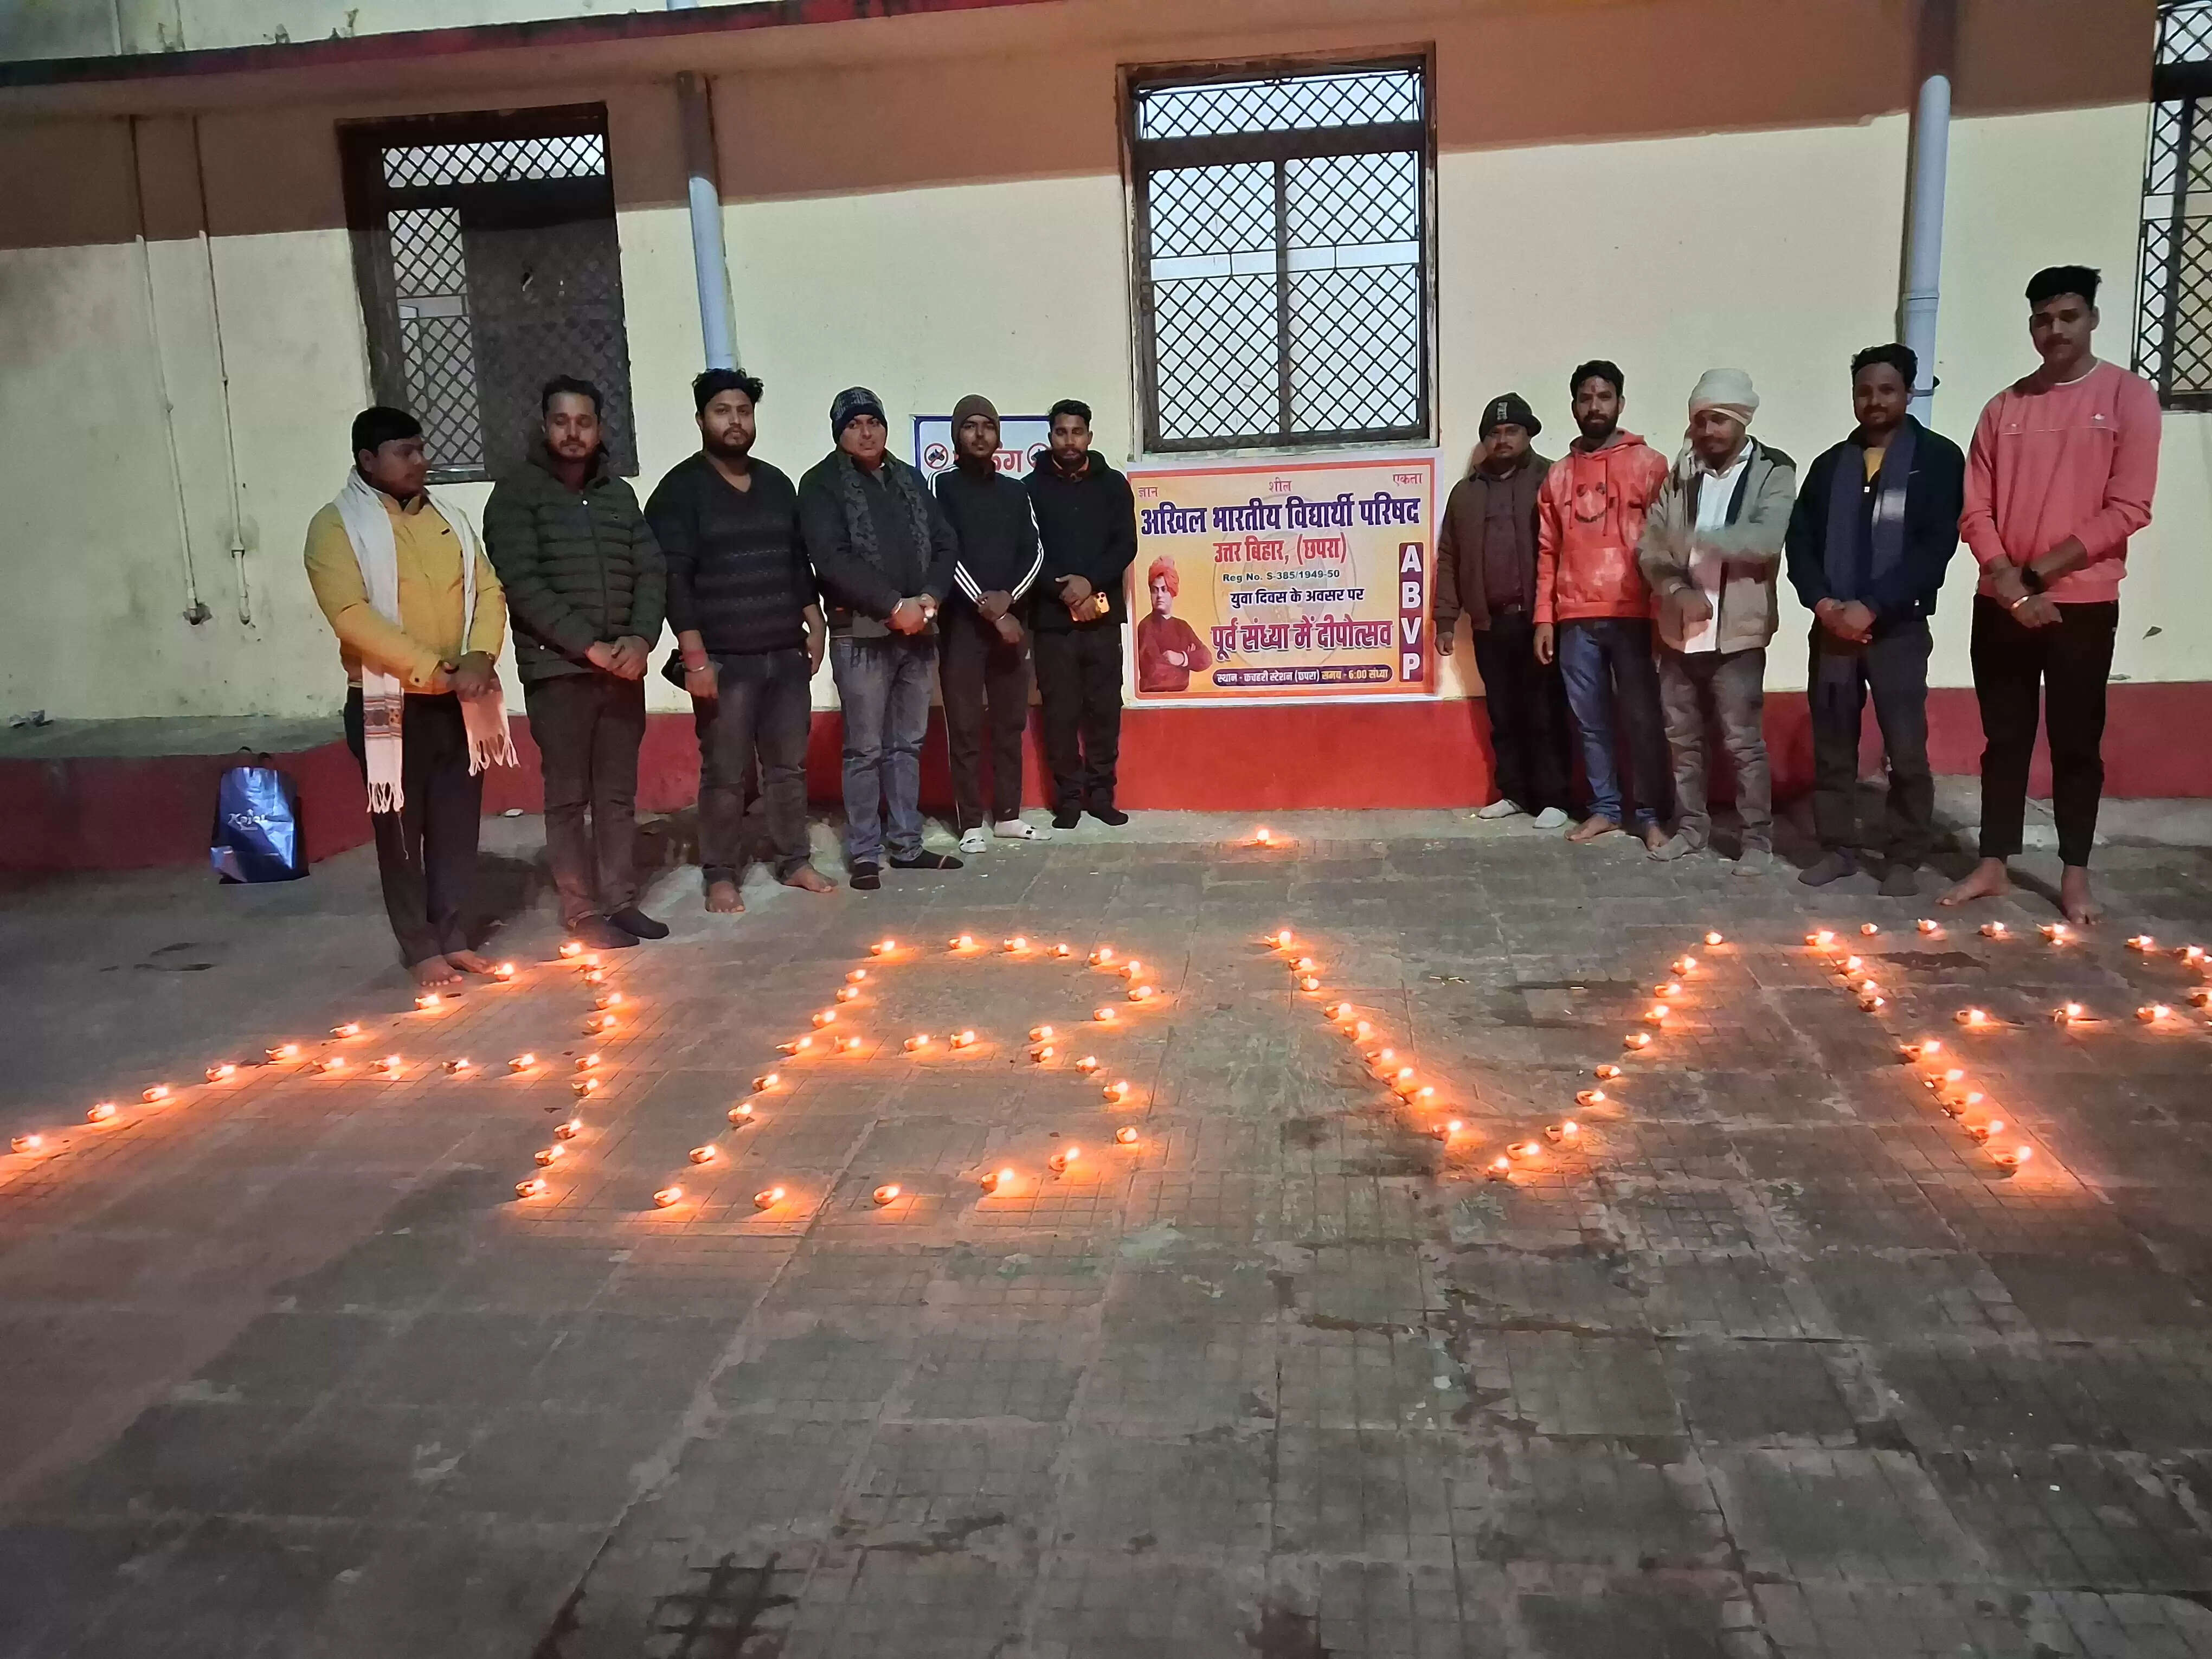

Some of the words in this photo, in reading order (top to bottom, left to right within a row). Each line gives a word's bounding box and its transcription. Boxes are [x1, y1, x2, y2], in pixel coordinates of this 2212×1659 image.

[1138, 486, 1158, 497] ज्ञान
[1269, 477, 1292, 492] शील
[1392, 473, 1423, 486] एकता
[1141, 501, 1207, 535] अखिल
[1212, 497, 1283, 532] भारतीय
[1359, 491, 1421, 525] परिषद
[1213, 542, 1242, 562] उत्तर
[1244, 535, 1289, 564] बिहार,
[1297, 532, 1346, 564] (छपरा)
[1223, 574, 1242, 583] Reg
[1266, 569, 1340, 580] S-385/1949-50
[1230, 593, 1252, 608] युवा
[1255, 589, 1287, 604] दिवस
[1290, 588, 1301, 601] के
[1306, 590, 1343, 602] अवसर
[1347, 588, 1365, 600] पर
[1211, 618, 1237, 662] पूर्व
[1241, 618, 1289, 651] संध्या
[1293, 615, 1316, 648] में
[1316, 613, 1393, 649] दीपोत्सव
[1217, 673, 1237, 683] स्थान
[1269, 670, 1293, 681] स्टेशन
[1295, 669, 1319, 683] (छपरा)
[1321, 671, 1342, 680] समय
[1348, 670, 1366, 679] 6:00
[1368, 667, 1388, 679] संध्या
